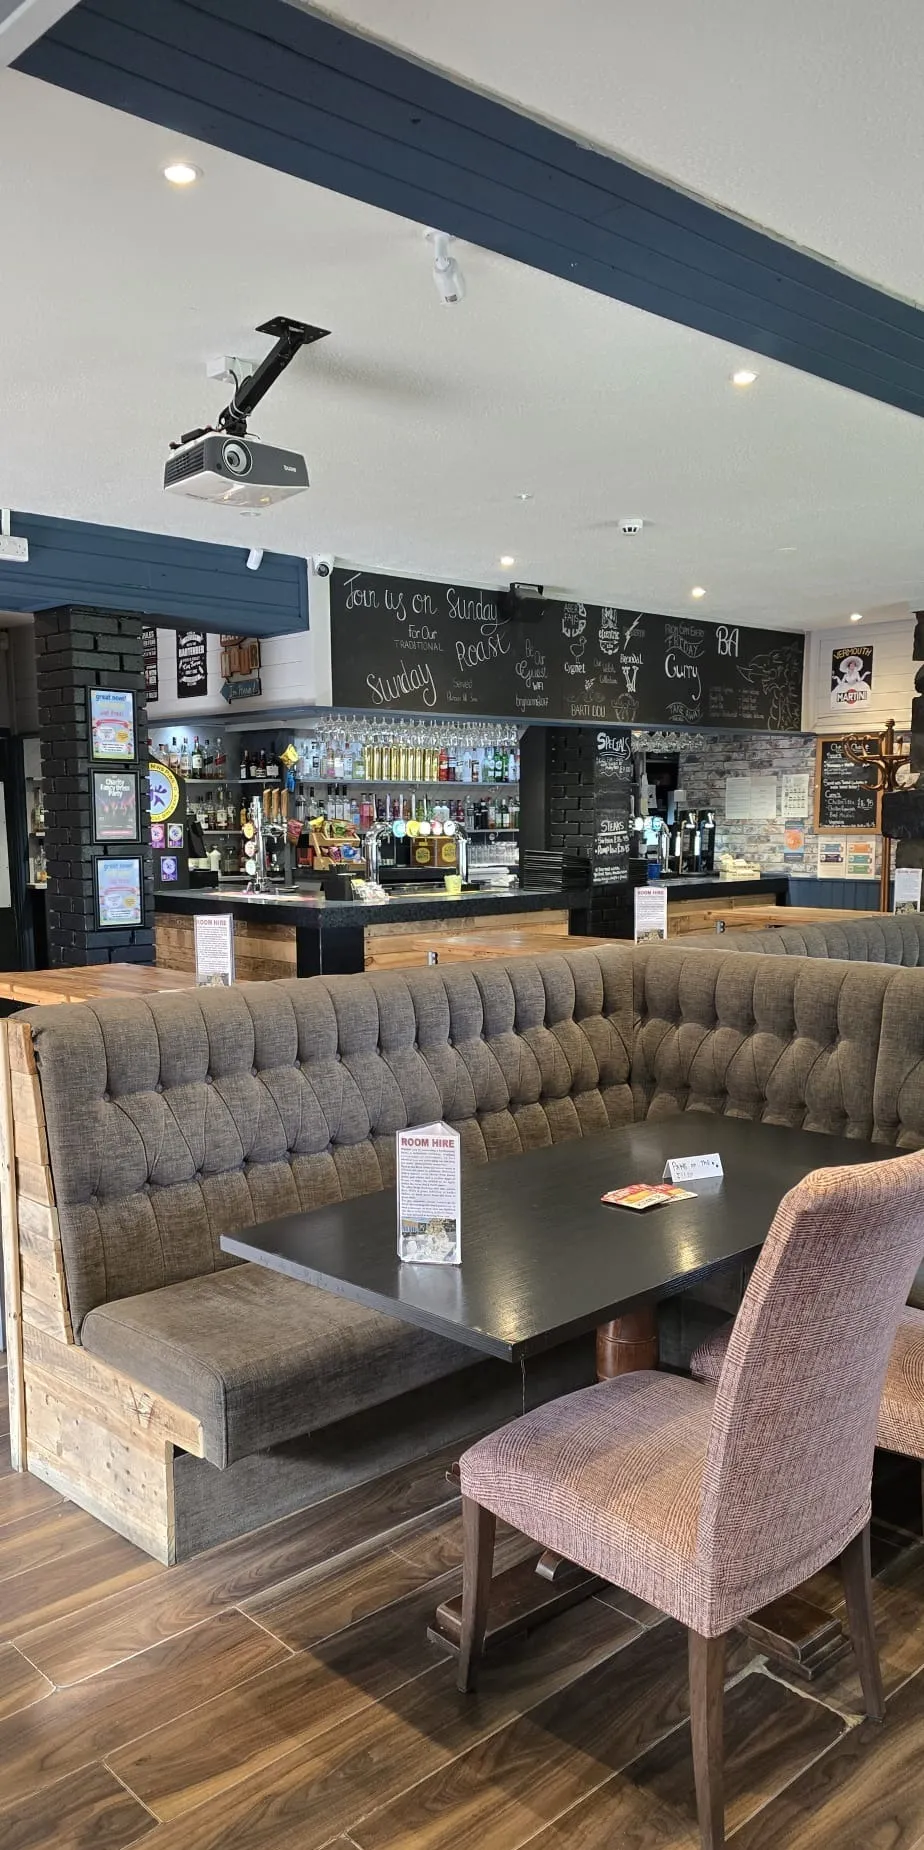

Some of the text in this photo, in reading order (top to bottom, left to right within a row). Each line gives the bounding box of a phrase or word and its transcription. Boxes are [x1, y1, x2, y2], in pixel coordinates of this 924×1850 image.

[343, 572, 511, 636] Join us on Sunday
[408, 624, 438, 640] For Our
[393, 639, 444, 652] TRADITIONAL
[715, 625, 739, 658] BA
[456, 631, 511, 672] Roast
[833, 646, 872, 660] VERMOUTH
[366, 659, 437, 707] Sunday
[665, 653, 701, 701] Curry
[837, 691, 868, 703] MARTINI
[597, 732, 631, 760] SPECIALS
[105, 778, 125, 786] Charity
[108, 790, 123, 798] Party
[600, 820, 624, 832] STEAKS
[401, 1137, 455, 1148] ROOM HIRE
